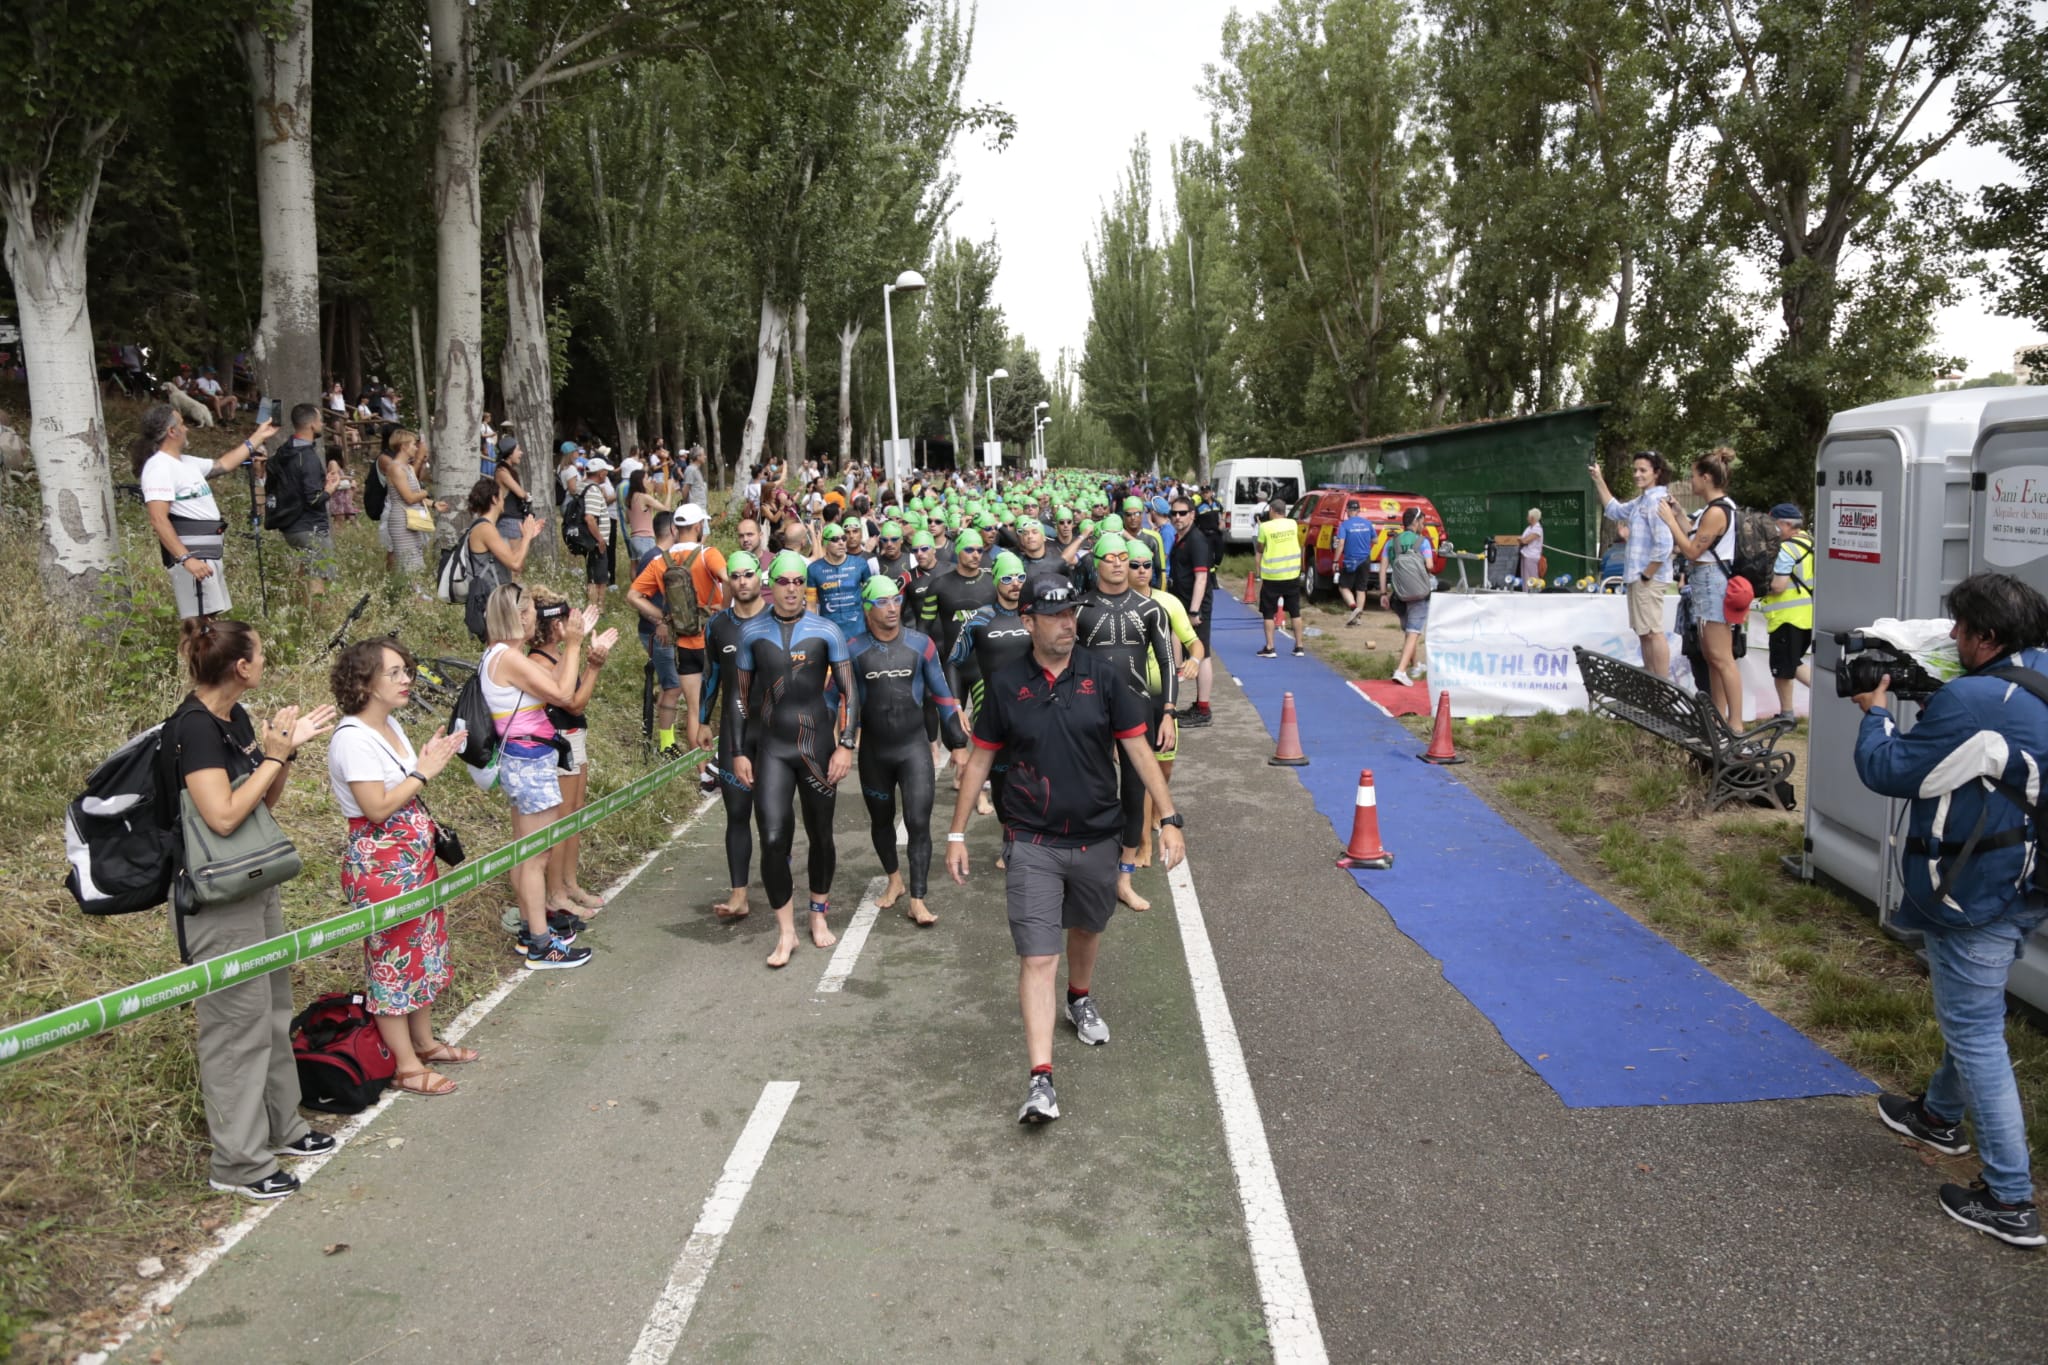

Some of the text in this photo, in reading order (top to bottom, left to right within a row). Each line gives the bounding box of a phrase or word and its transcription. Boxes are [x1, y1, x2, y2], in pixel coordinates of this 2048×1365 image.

[2020, 479, 2048, 504] Eve
[1853, 511, 1878, 531] Miguel
[1431, 651, 1569, 677] TRIATHLON
[324, 920, 366, 942] IBERDROLA
[240, 948, 289, 972] IBERDROLA
[142, 980, 199, 1008] IBERDROLA
[22, 1018, 91, 1051] IBERDROLA
